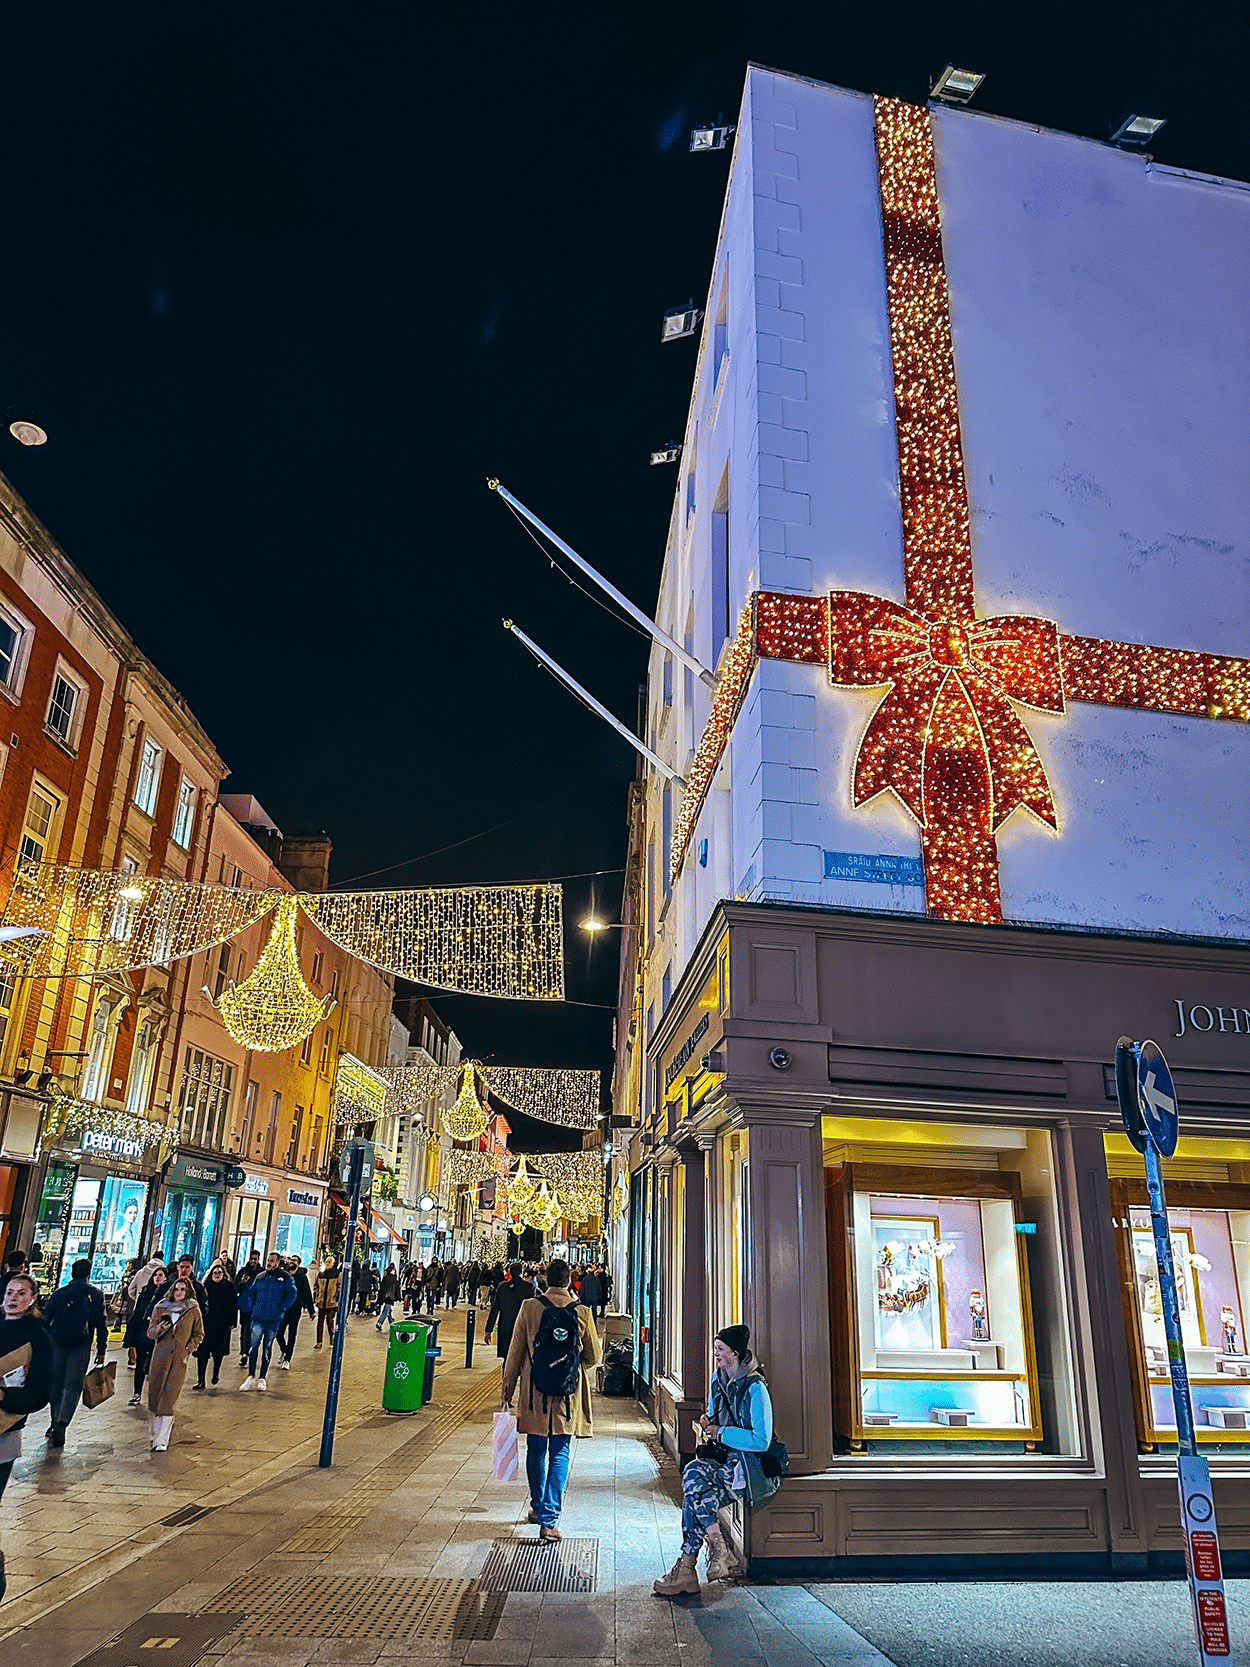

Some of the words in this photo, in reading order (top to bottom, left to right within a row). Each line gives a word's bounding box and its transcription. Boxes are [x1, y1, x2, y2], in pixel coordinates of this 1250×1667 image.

[874, 859, 897, 869] ANNA
[830, 866, 860, 877] ANNE
[863, 869, 901, 881] STREET
